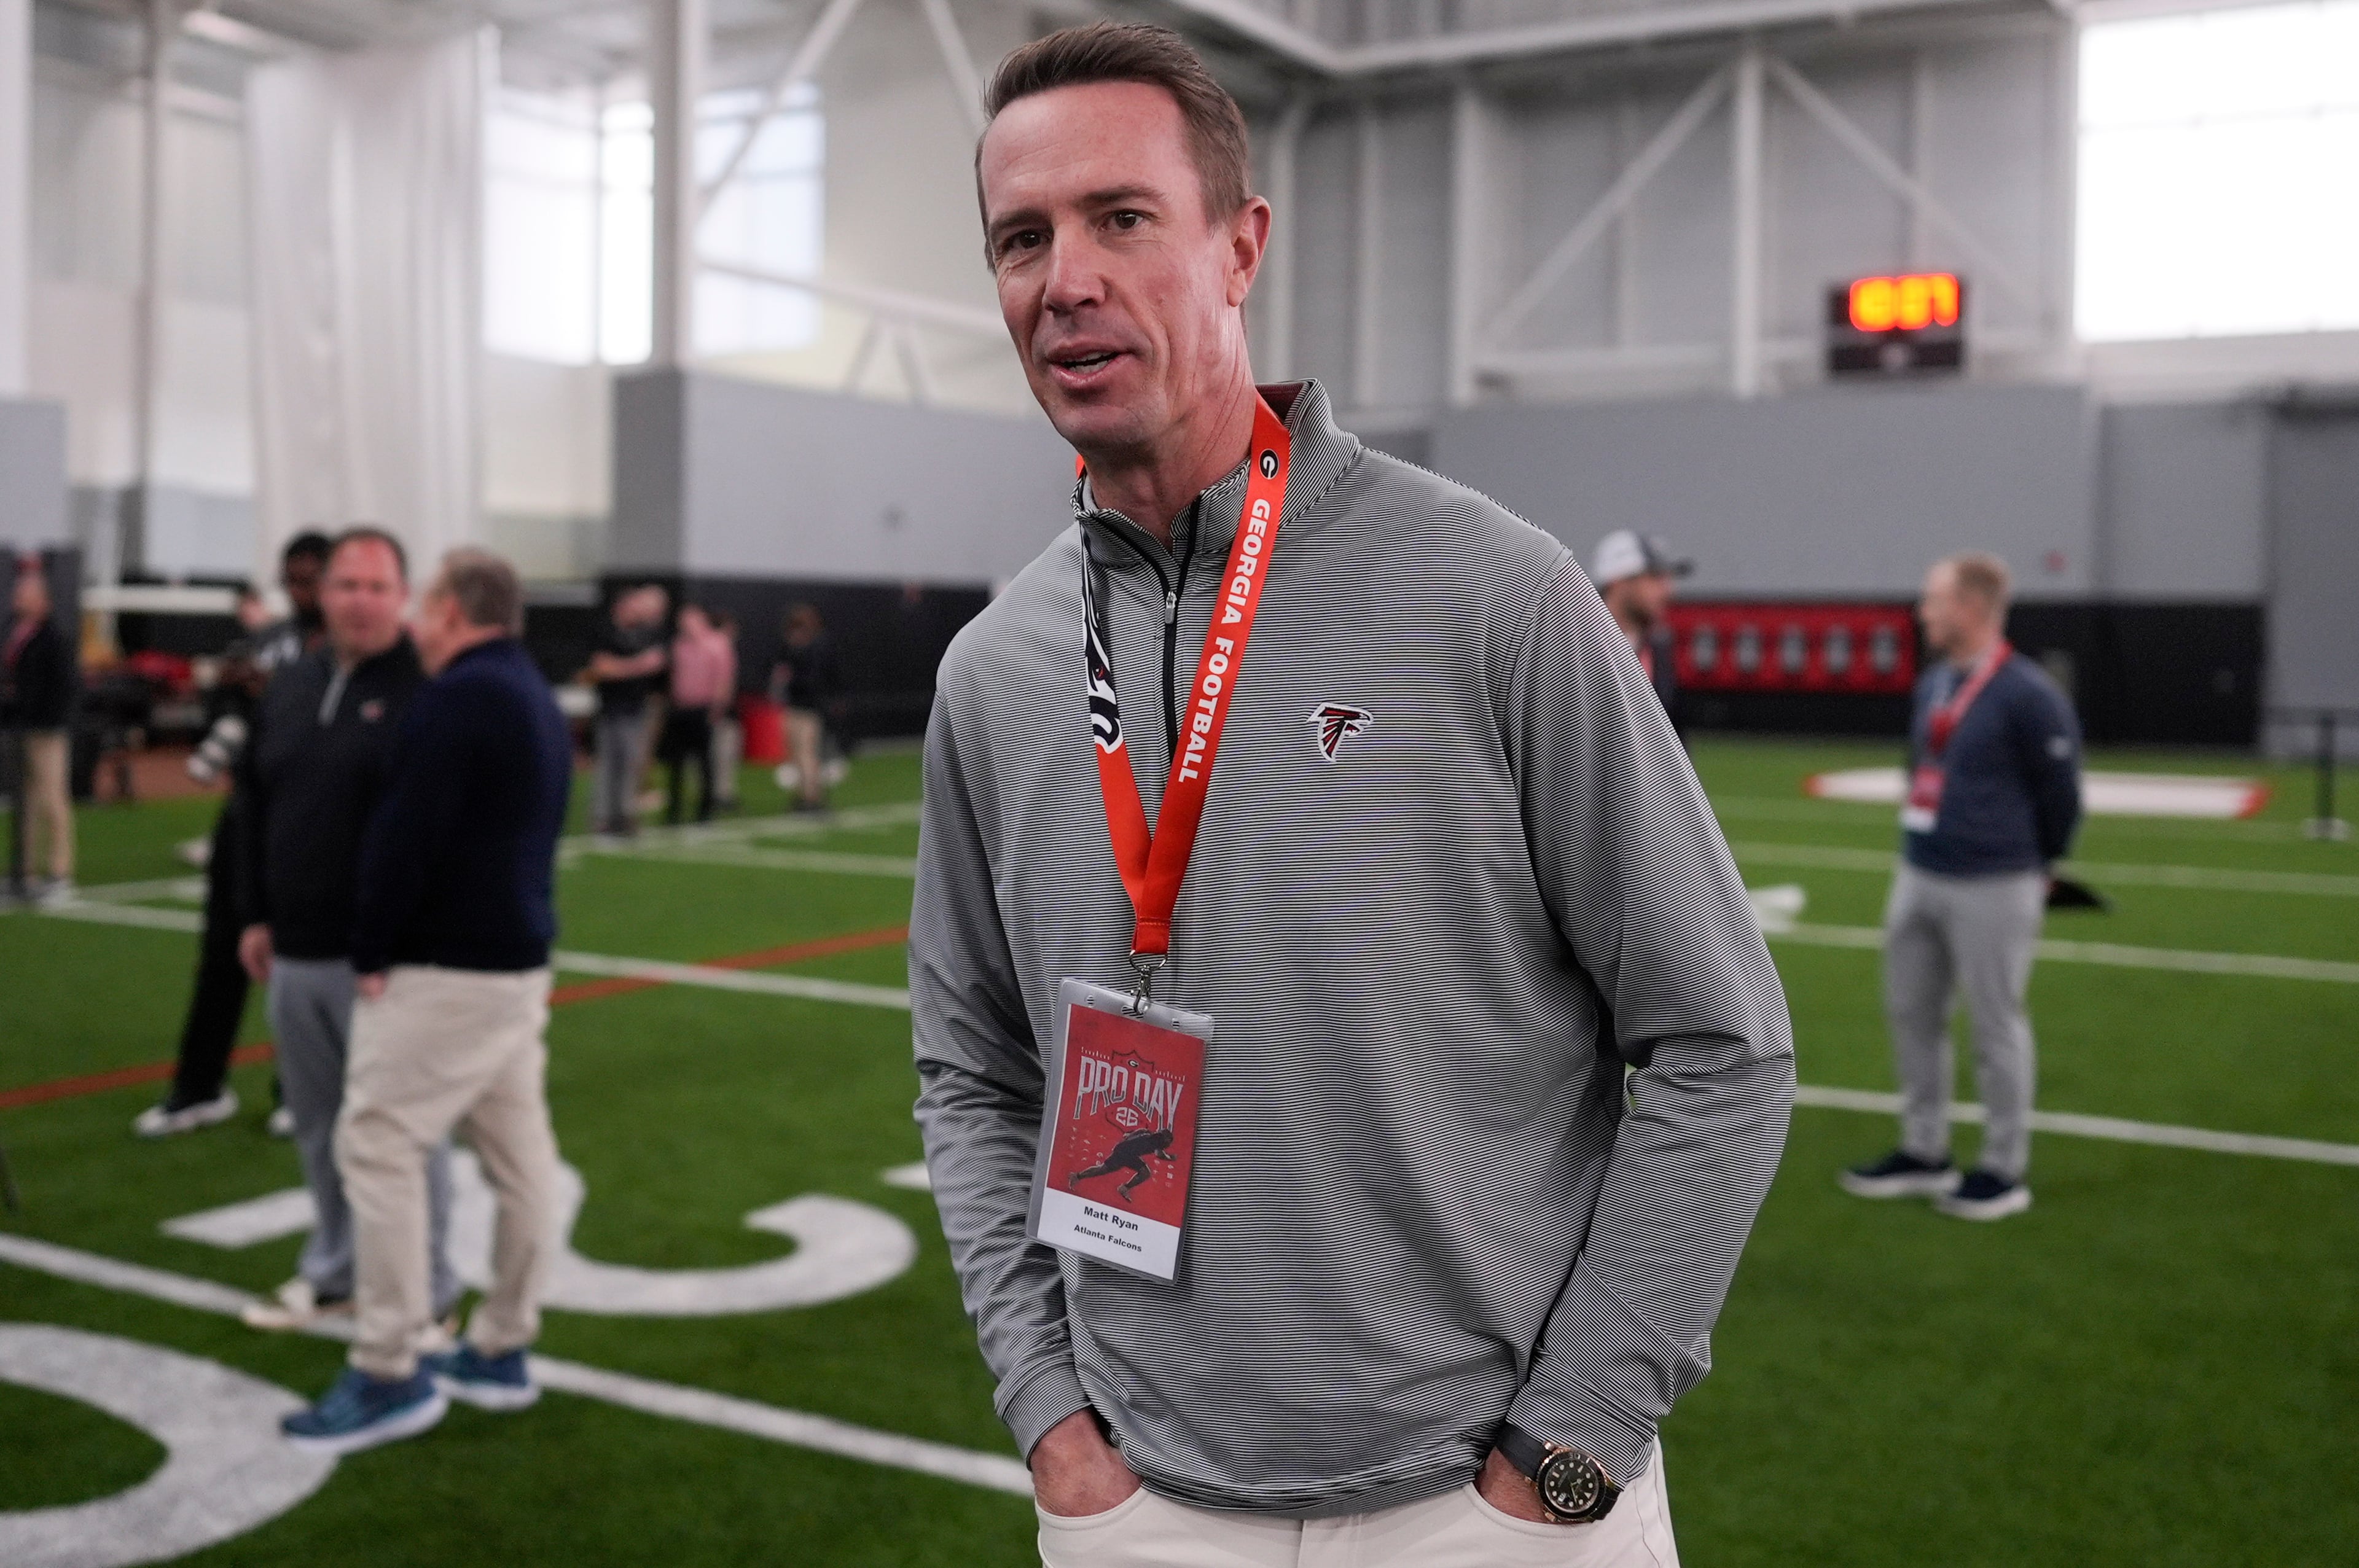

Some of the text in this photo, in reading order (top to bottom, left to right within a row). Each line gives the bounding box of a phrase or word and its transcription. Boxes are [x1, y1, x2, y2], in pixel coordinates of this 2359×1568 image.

[1178, 498, 1270, 782] GEORGIA FOOTBALL
[1073, 1056, 1183, 1133] PRO DAY
[1116, 1107, 1138, 1126] 26
[1084, 1206, 1138, 1231] Matt Ryan
[1074, 1225, 1142, 1252] Atlanta Falcons
